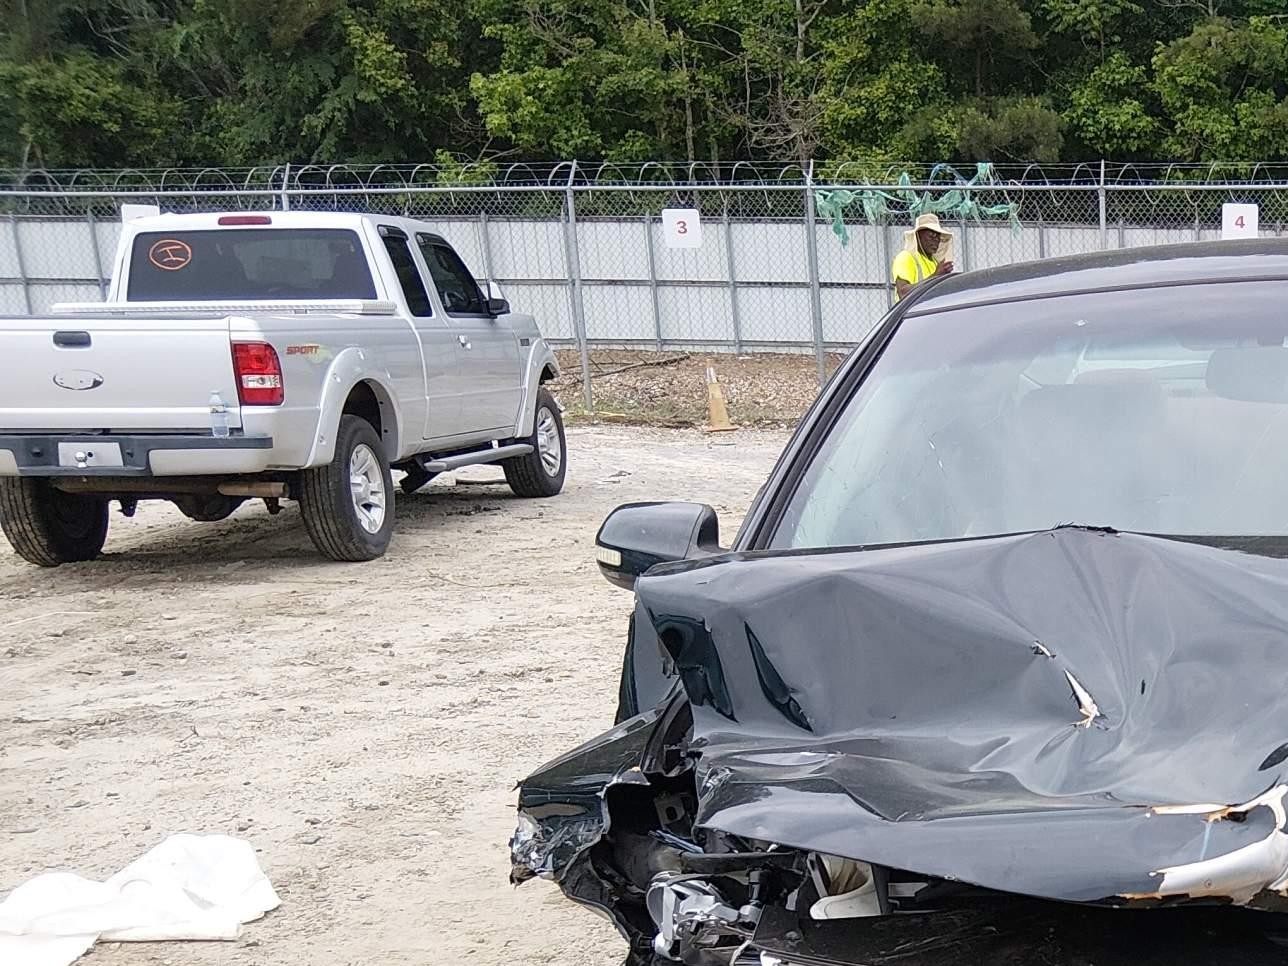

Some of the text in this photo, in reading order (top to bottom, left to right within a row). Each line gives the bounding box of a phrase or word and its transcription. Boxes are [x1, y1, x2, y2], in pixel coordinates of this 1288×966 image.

[676, 220, 688, 235] 3
[1235, 215, 1246, 229] 4
[286, 344, 320, 356] SPORT
